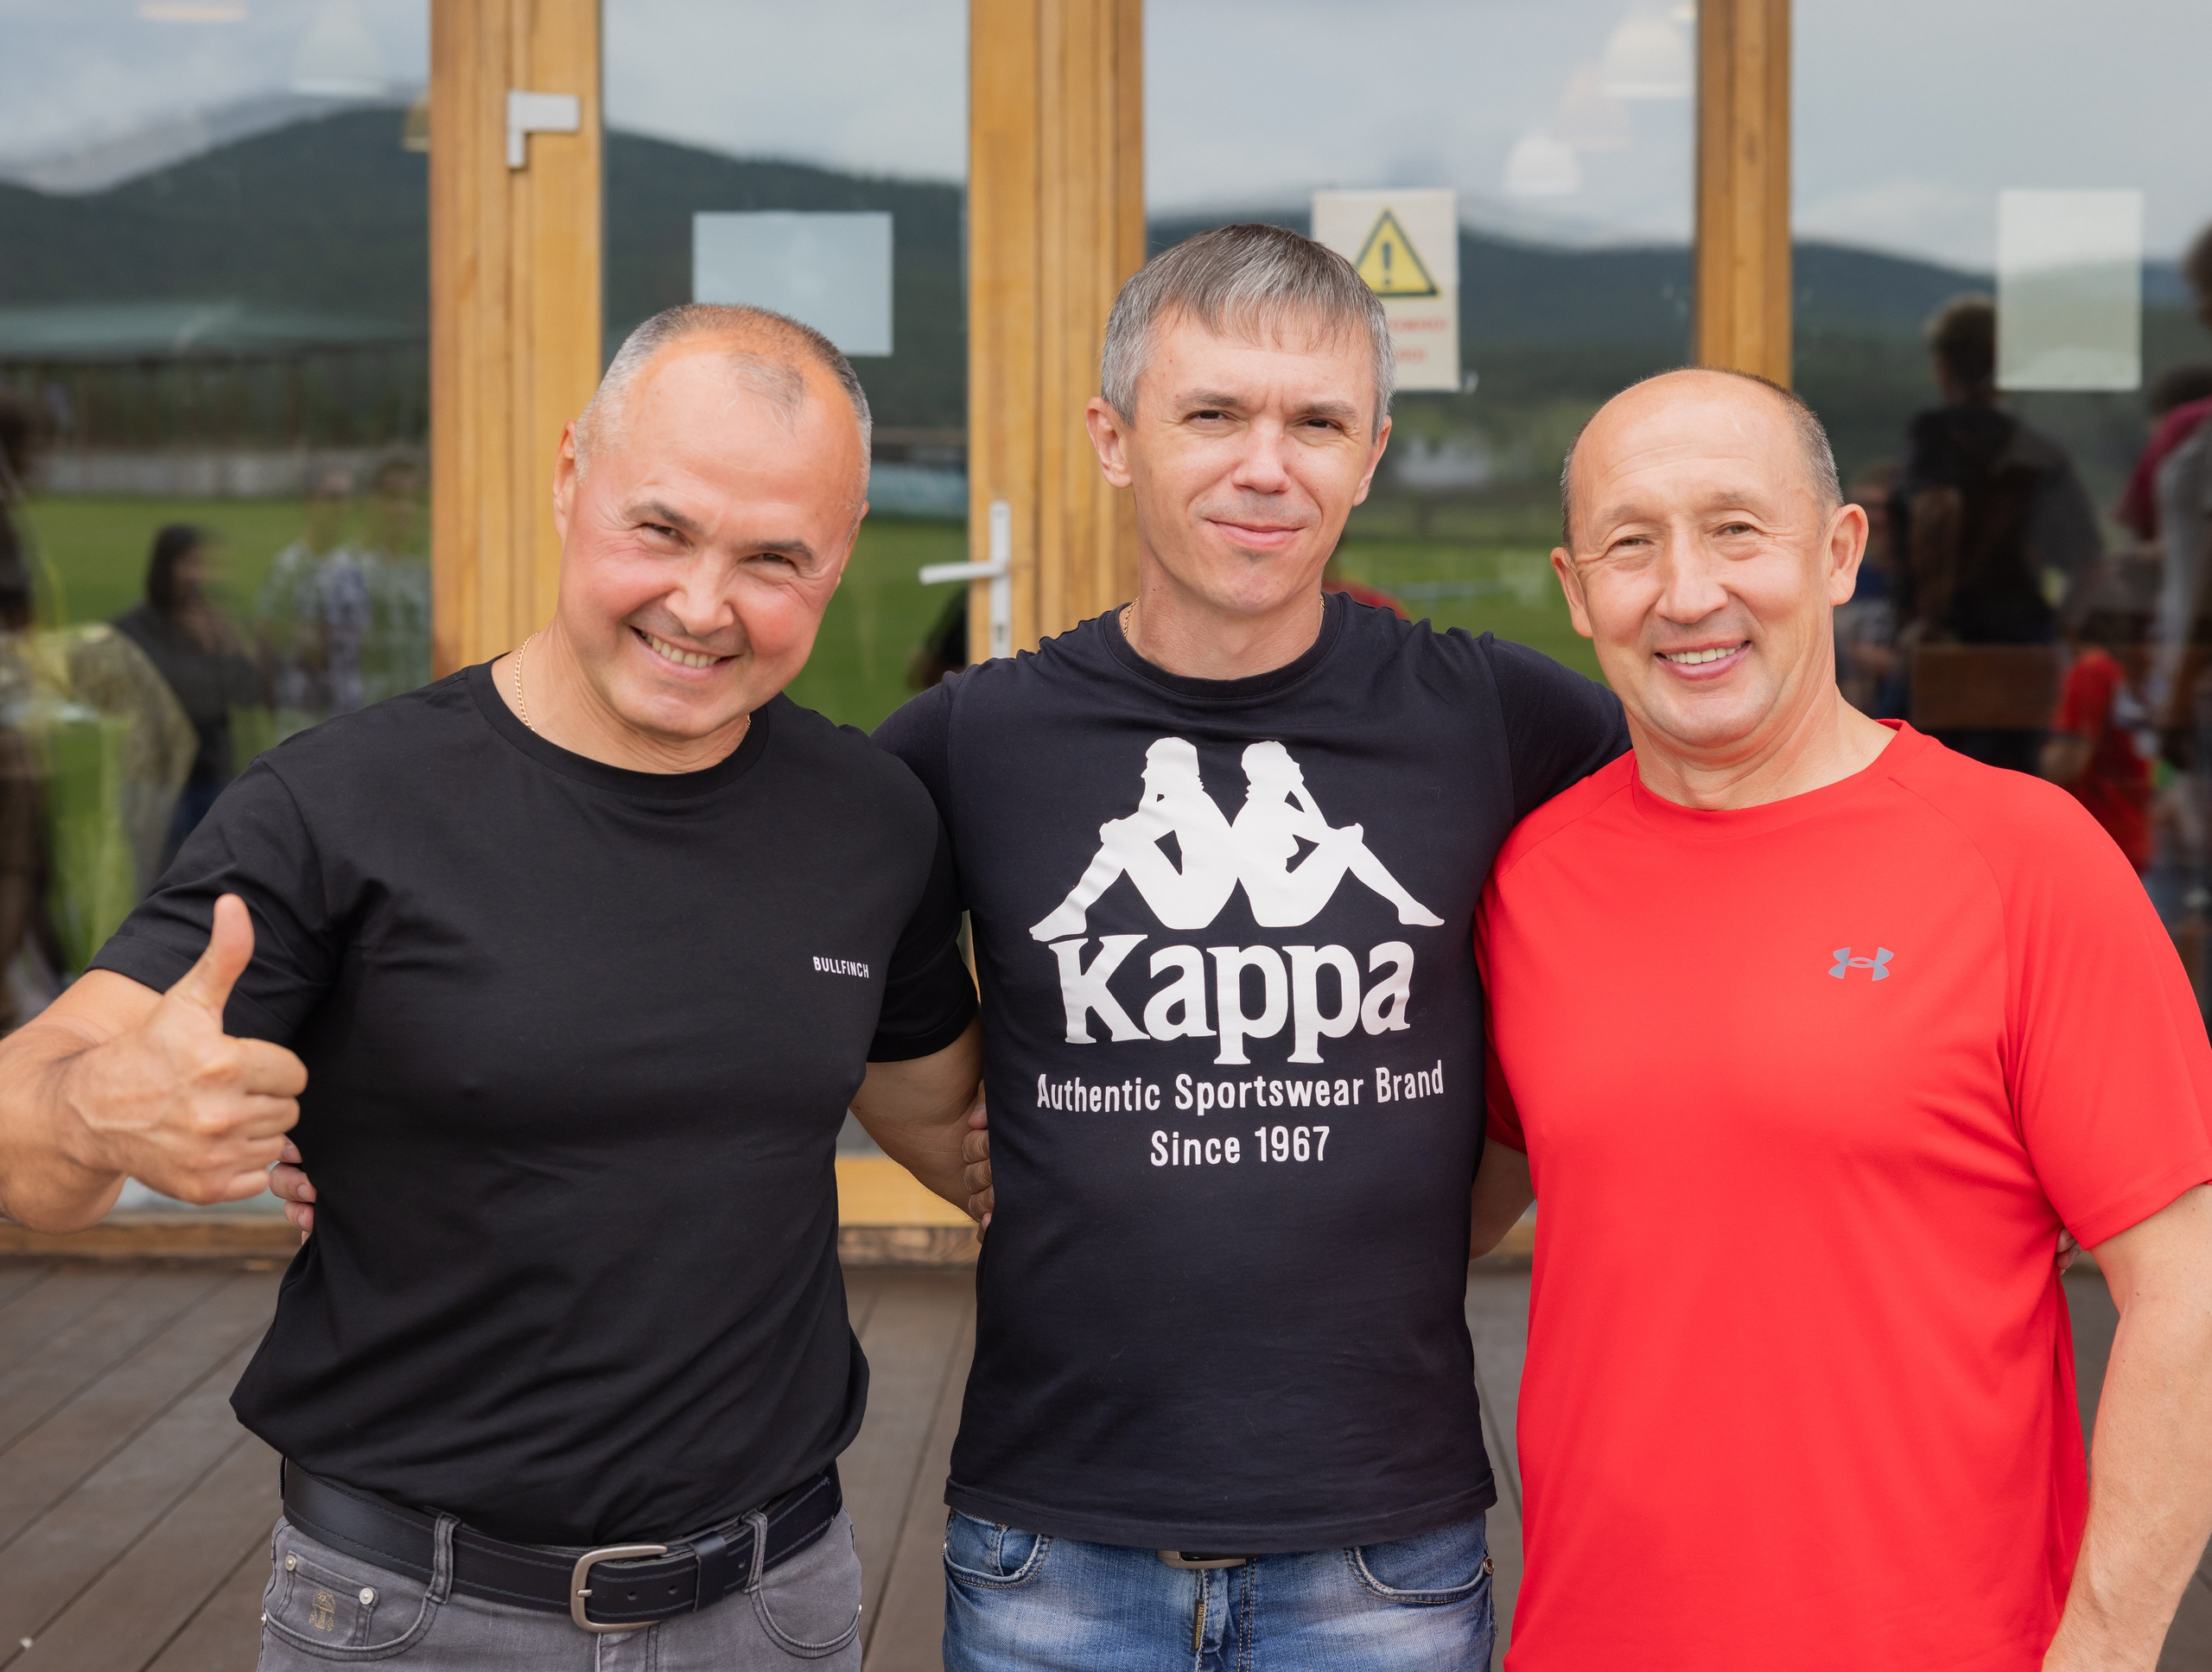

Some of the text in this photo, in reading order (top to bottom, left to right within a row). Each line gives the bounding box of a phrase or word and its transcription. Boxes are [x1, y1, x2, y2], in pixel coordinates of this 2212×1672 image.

[813, 957, 868, 978] BULLFINCH
[1048, 934, 1414, 1065] Kappa
[1037, 1060, 1444, 1116] Authentic Sportswear Brand
[1151, 1126, 1330, 1167] Since 1967
